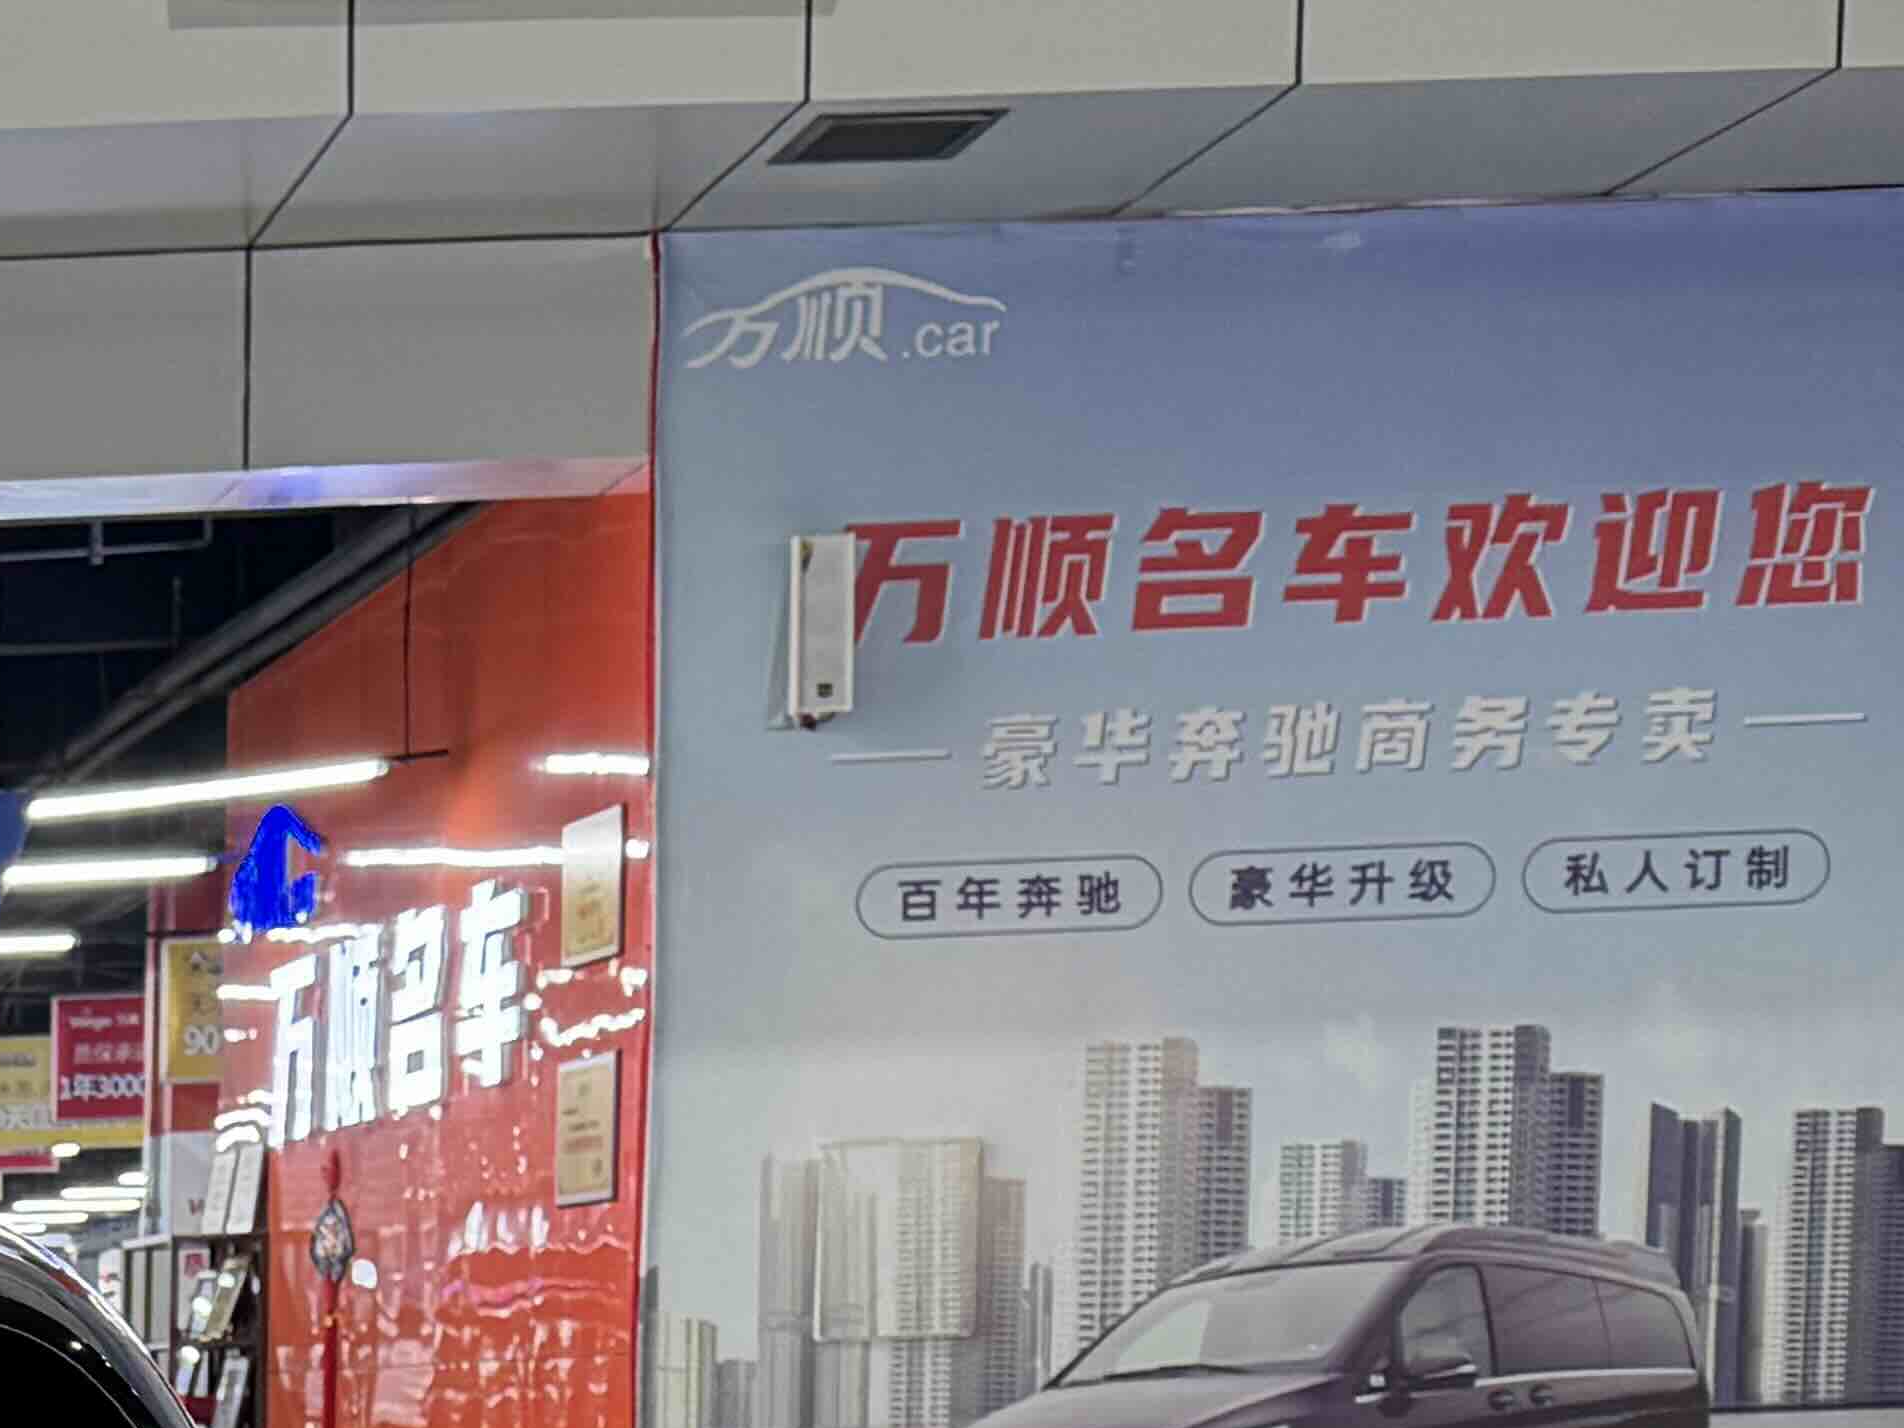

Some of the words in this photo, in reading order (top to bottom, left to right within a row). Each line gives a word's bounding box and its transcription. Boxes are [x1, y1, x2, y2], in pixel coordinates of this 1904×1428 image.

[844, 481, 1875, 645] 万顺名车欢迎您
[980, 688, 1719, 790] 豪华奔驰商务专卖
[896, 872, 1124, 924] 百年奔驰
[1227, 859, 1457, 912] 豪华升级
[1564, 846, 1793, 898] 私人订制
[266, 878, 524, 1152] 万顺名车
